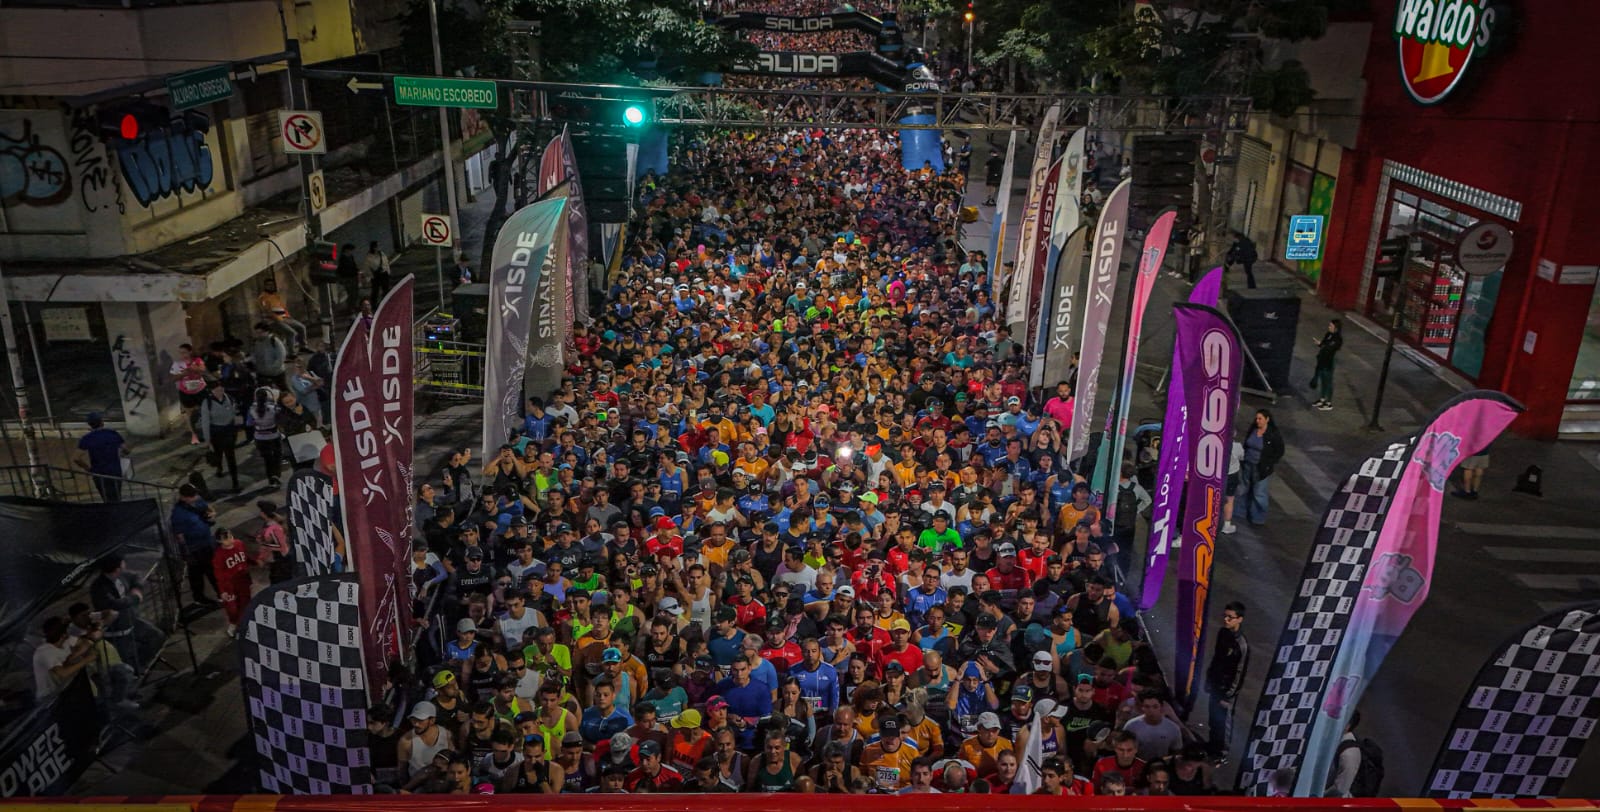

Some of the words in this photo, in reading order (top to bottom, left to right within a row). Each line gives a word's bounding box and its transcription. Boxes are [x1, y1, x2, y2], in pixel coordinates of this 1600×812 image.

[765, 17, 833, 31] SALIDA
[1396, 0, 1495, 46] Waldo's
[734, 53, 838, 73] ALIDA
[172, 83, 200, 105] ALVARO
[399, 87, 440, 101] MARIANO
[443, 88, 492, 103] ESCOBEDO
[1043, 182, 1057, 232] ISDE
[505, 231, 537, 294] ISDE
[1098, 220, 1117, 283] ISDE
[539, 242, 554, 338] SINALOA
[1060, 285, 1074, 326] ISDE
[382, 326, 401, 411] ISDE
[343, 376, 380, 470] ISDE
[1196, 329, 1231, 480] 96.9
[1158, 473, 1169, 507] LOS
[1561, 676, 1570, 690] ISDE
[0, 722, 64, 798] OWER
